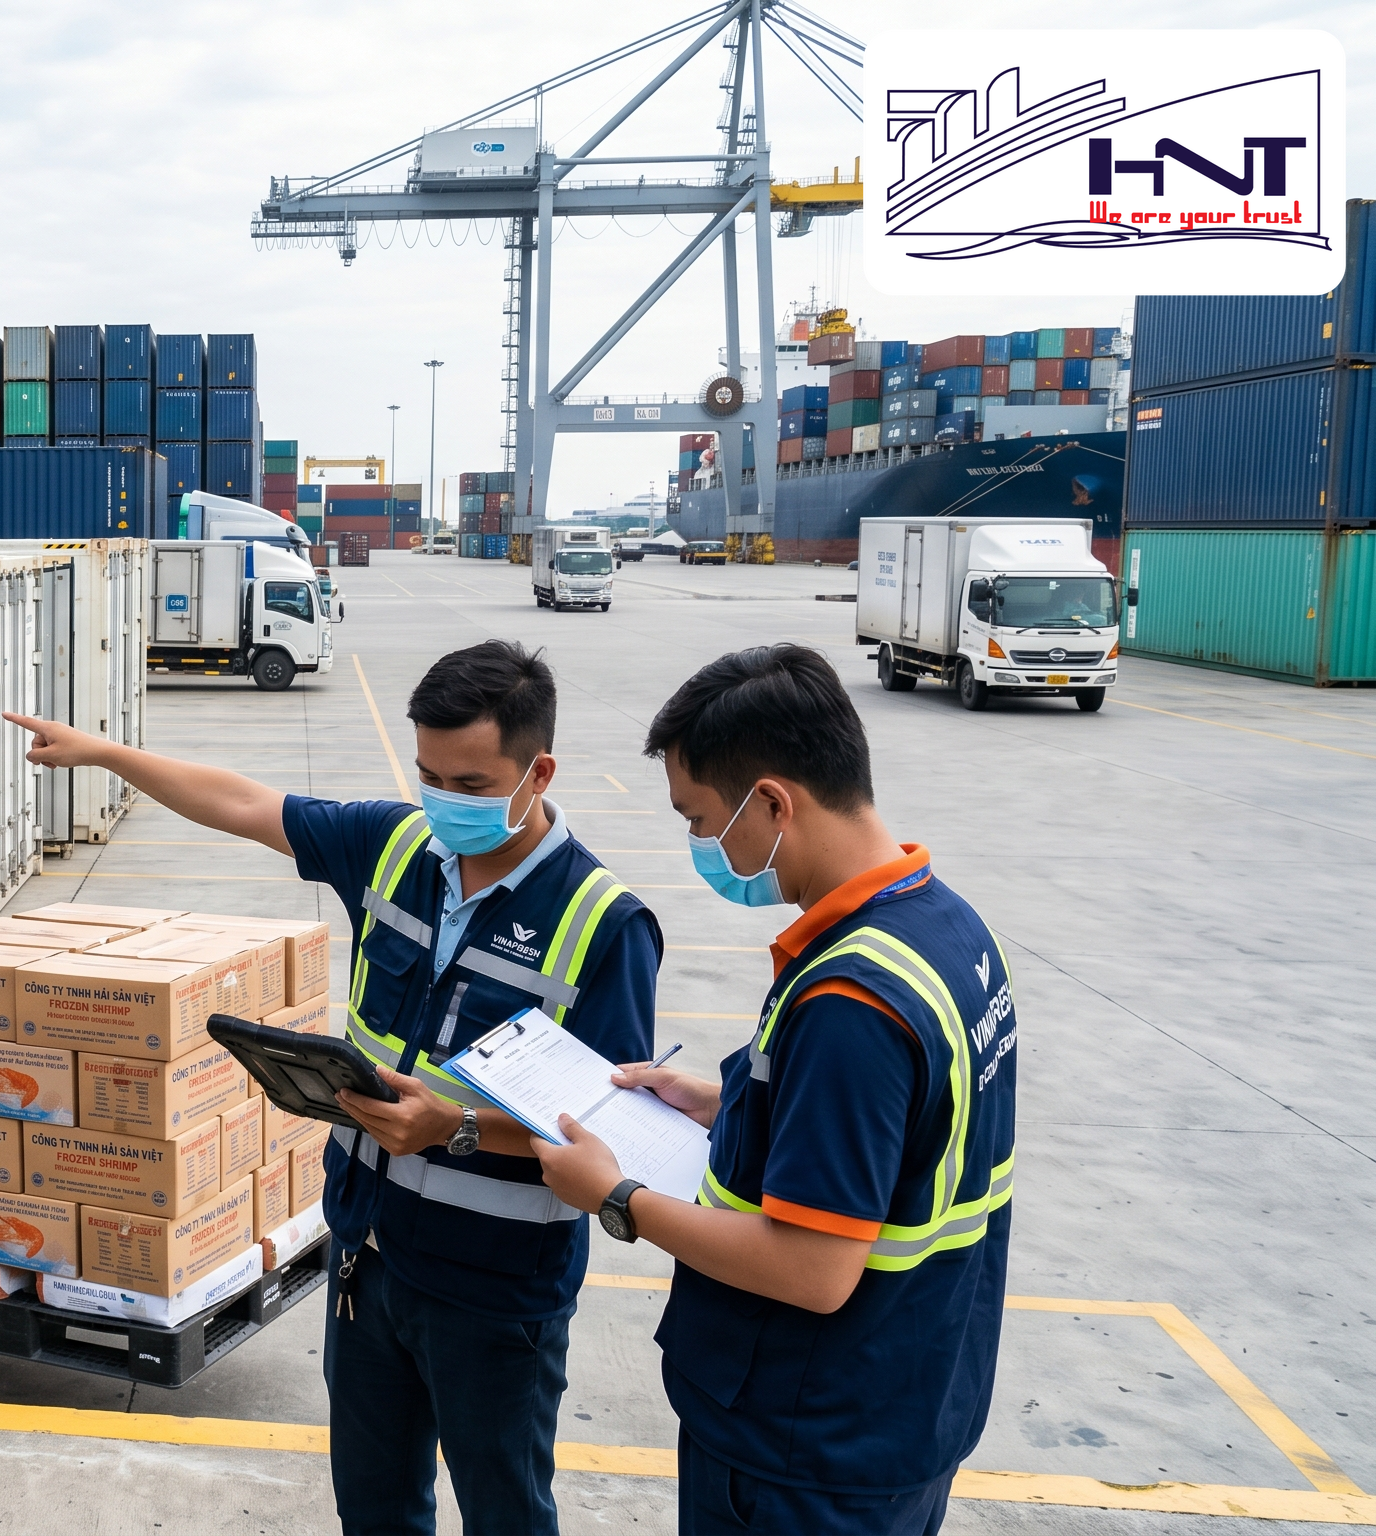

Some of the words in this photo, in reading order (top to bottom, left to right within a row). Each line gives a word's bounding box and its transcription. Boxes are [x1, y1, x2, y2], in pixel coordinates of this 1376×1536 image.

[52, 985, 63, 995] TY
[66, 987, 91, 998] TNHH
[134, 992, 156, 1006] VIỆT
[59, 1138, 71, 1149] TY
[57, 1152, 96, 1166] FROZEN
[99, 1158, 138, 1172] SHRIMP
